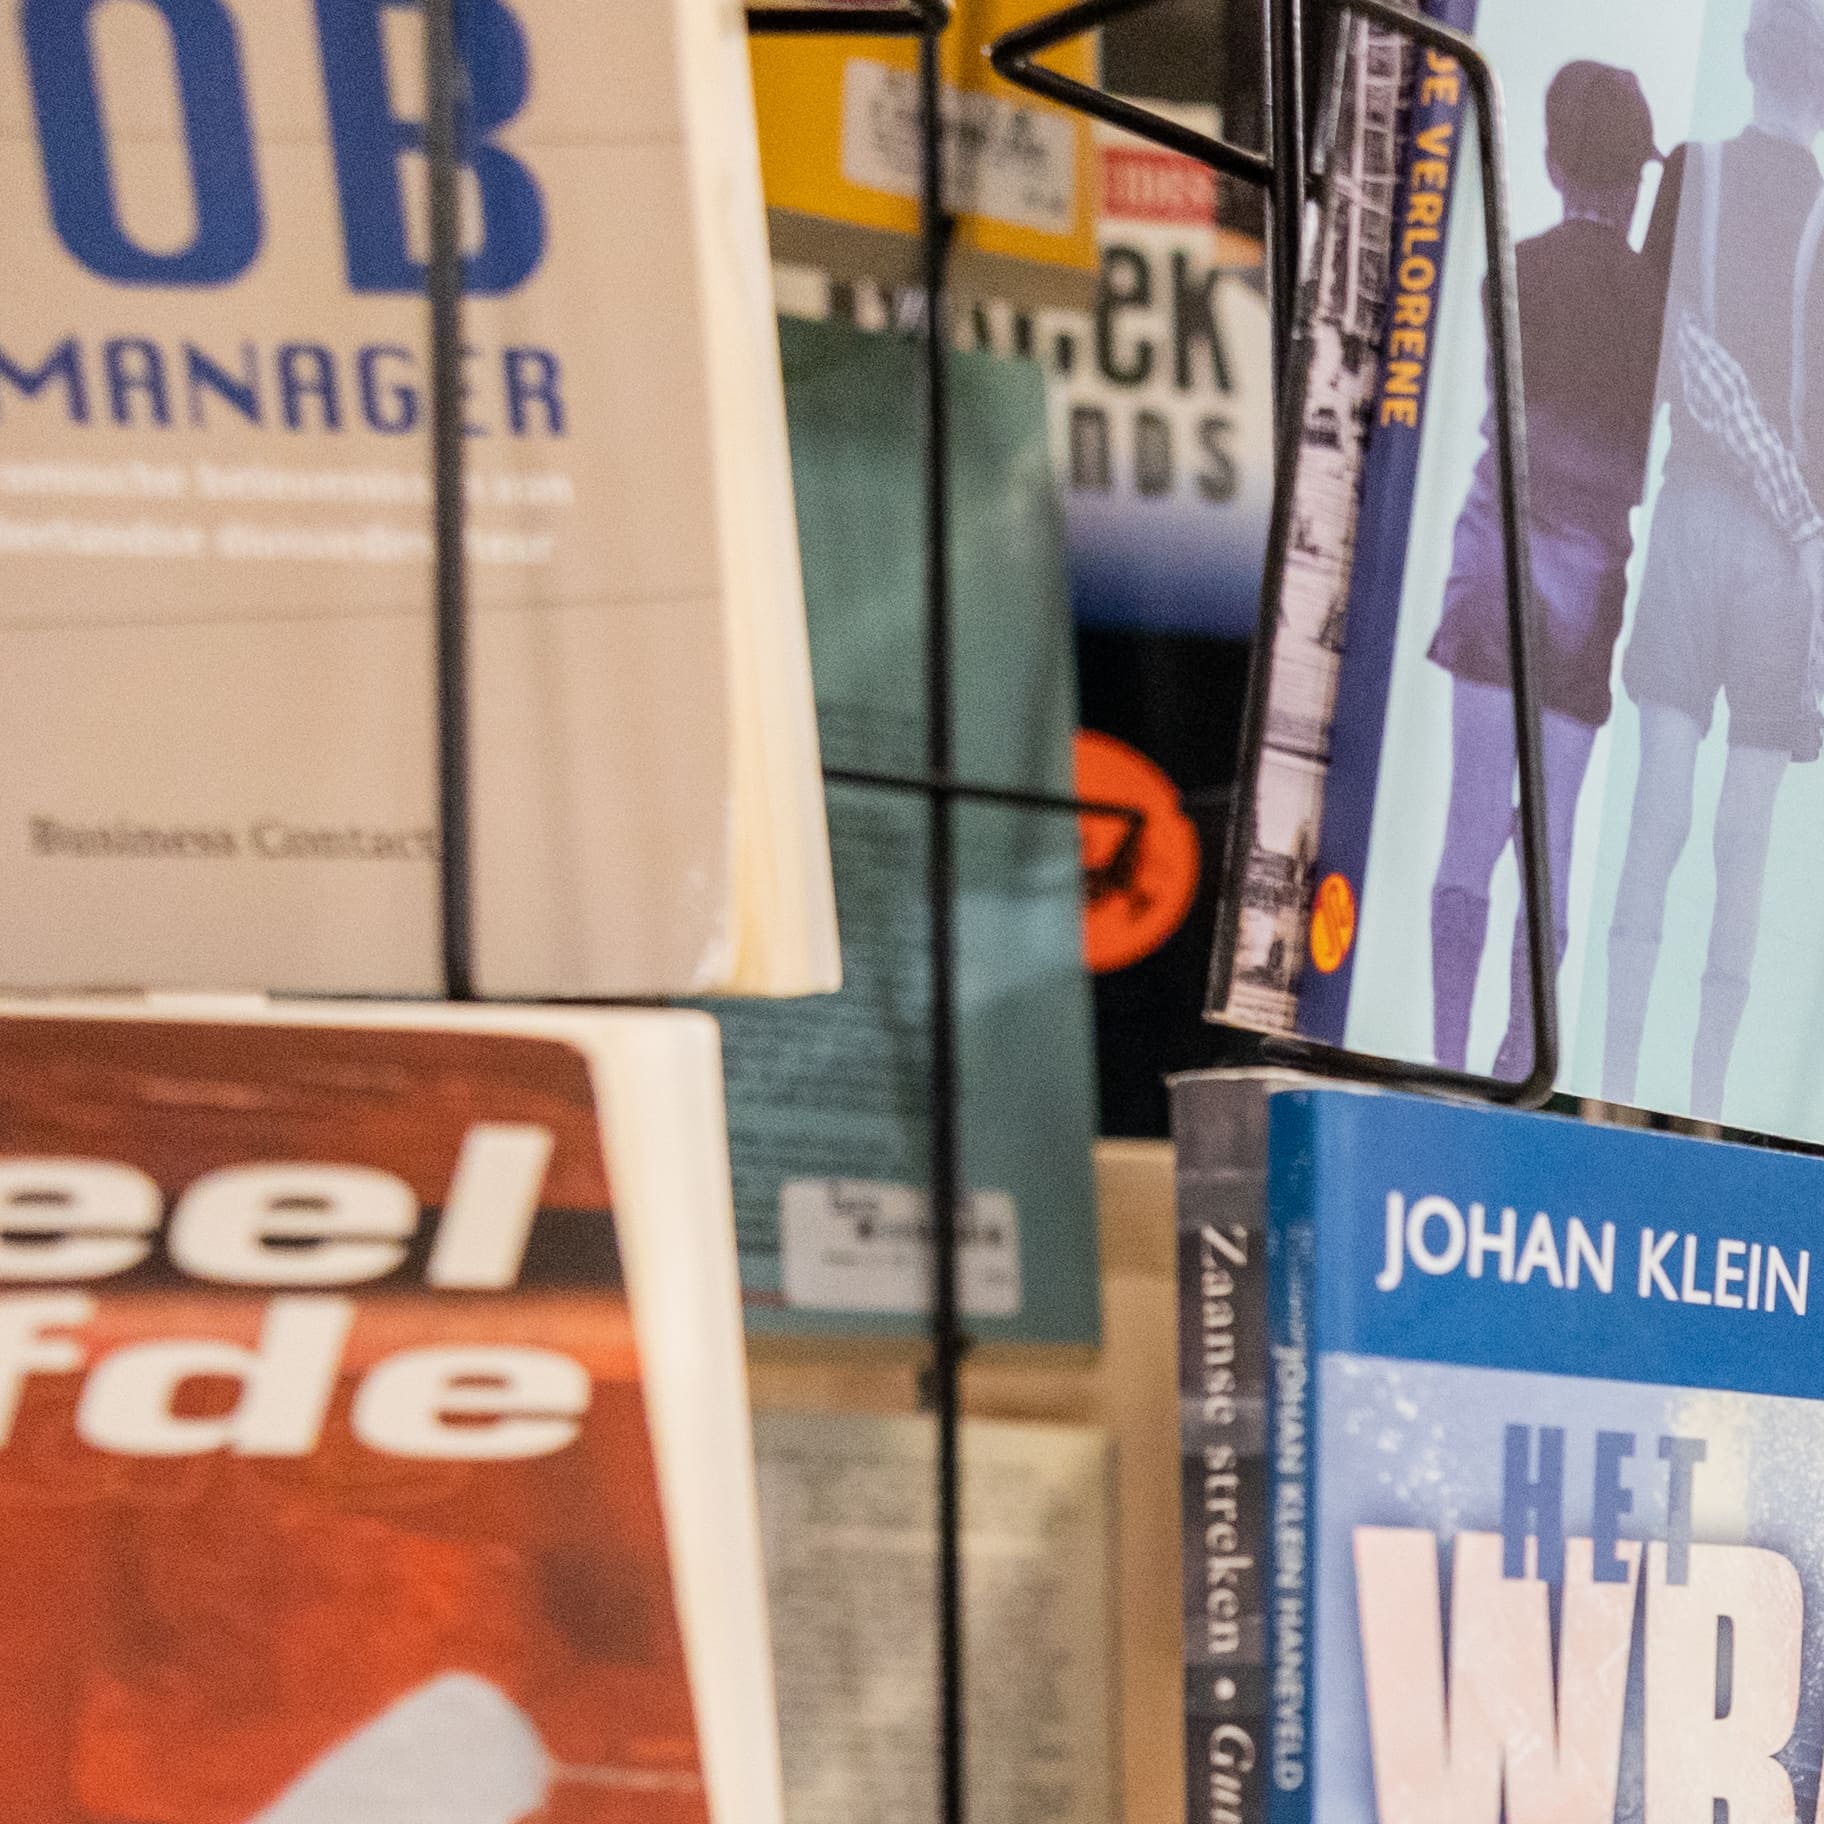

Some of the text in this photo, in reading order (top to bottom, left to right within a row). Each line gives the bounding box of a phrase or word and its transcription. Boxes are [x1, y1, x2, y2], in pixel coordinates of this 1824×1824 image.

[1379, 122, 1456, 429] VERLORENE
[1201, 1223, 1249, 1426] Zaanse
[1375, 1190, 1615, 1294] JOHAN
[1638, 1228, 1811, 1316] KLEIN
[1271, 1344, 1308, 1474] JOHAN
[1502, 1423, 1707, 1586] HET
[1204, 1443, 1254, 1654] streken
[1272, 1598, 1306, 1792] HANEVELD
